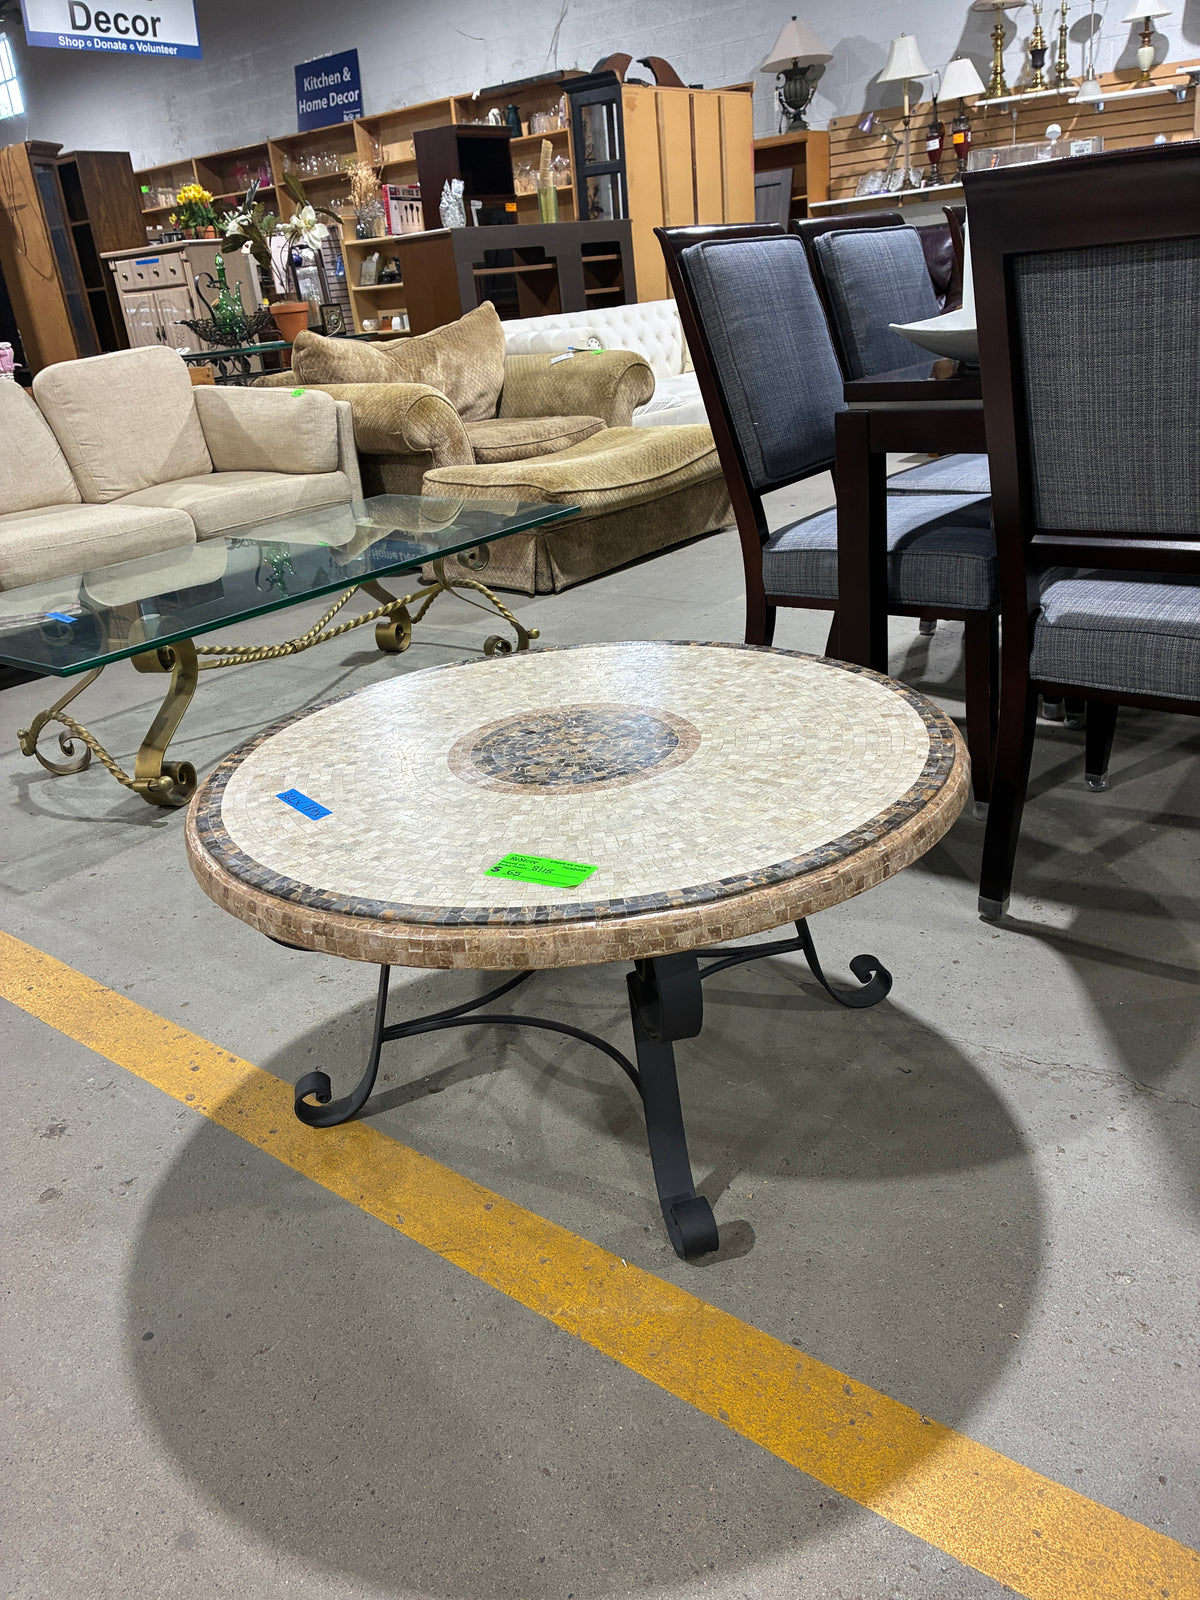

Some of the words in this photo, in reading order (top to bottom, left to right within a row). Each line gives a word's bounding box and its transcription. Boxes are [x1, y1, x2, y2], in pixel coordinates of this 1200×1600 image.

[68, 0, 161, 38] Decor
[58, 35, 85, 50] Shop
[94, 42, 128, 51] Donate
[136, 43, 178, 56] Volunteer
[303, 72, 341, 92] Kitchen
[342, 66, 352, 82] &
[298, 97, 328, 114] Home
[329, 89, 360, 107] Decor
